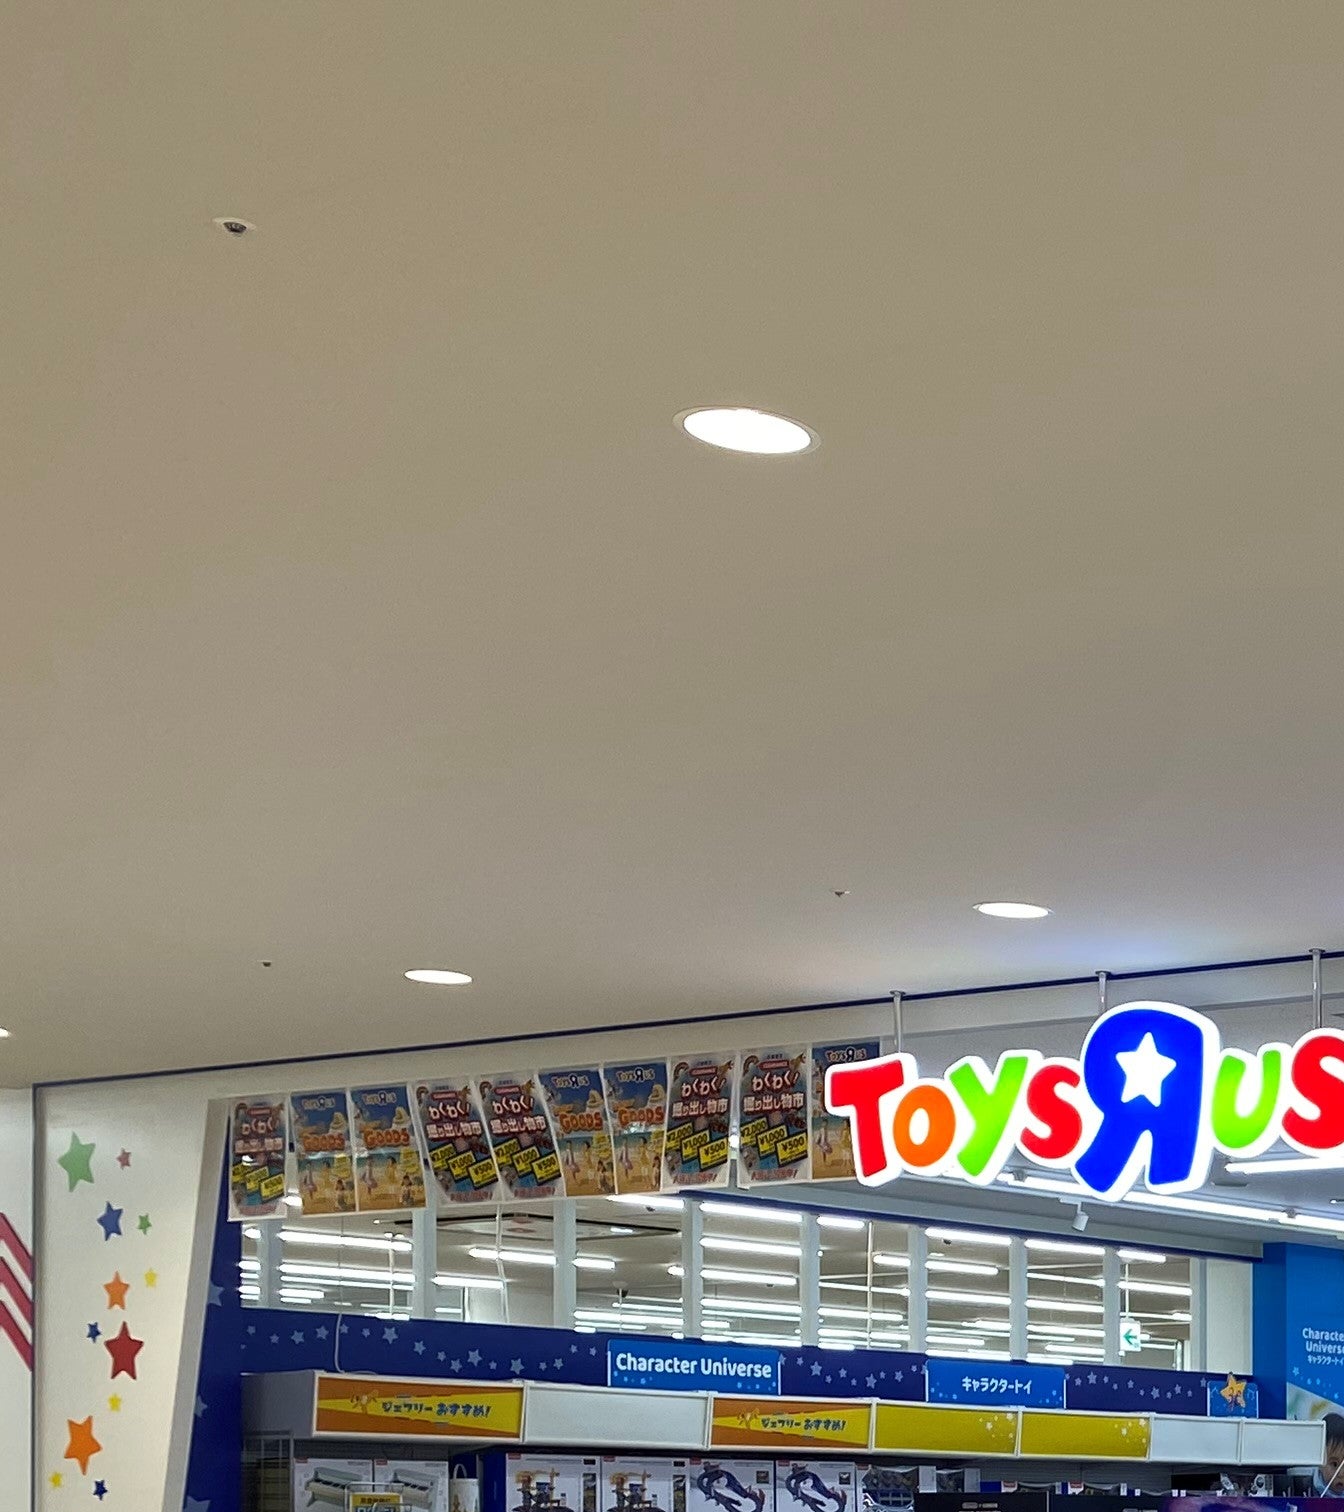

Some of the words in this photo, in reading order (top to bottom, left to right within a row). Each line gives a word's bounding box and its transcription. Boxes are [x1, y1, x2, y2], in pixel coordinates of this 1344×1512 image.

[616, 1352, 697, 1375] Character
[700, 1358, 772, 1378] Universe
[962, 1376, 1032, 1394] キャラクタートイ
